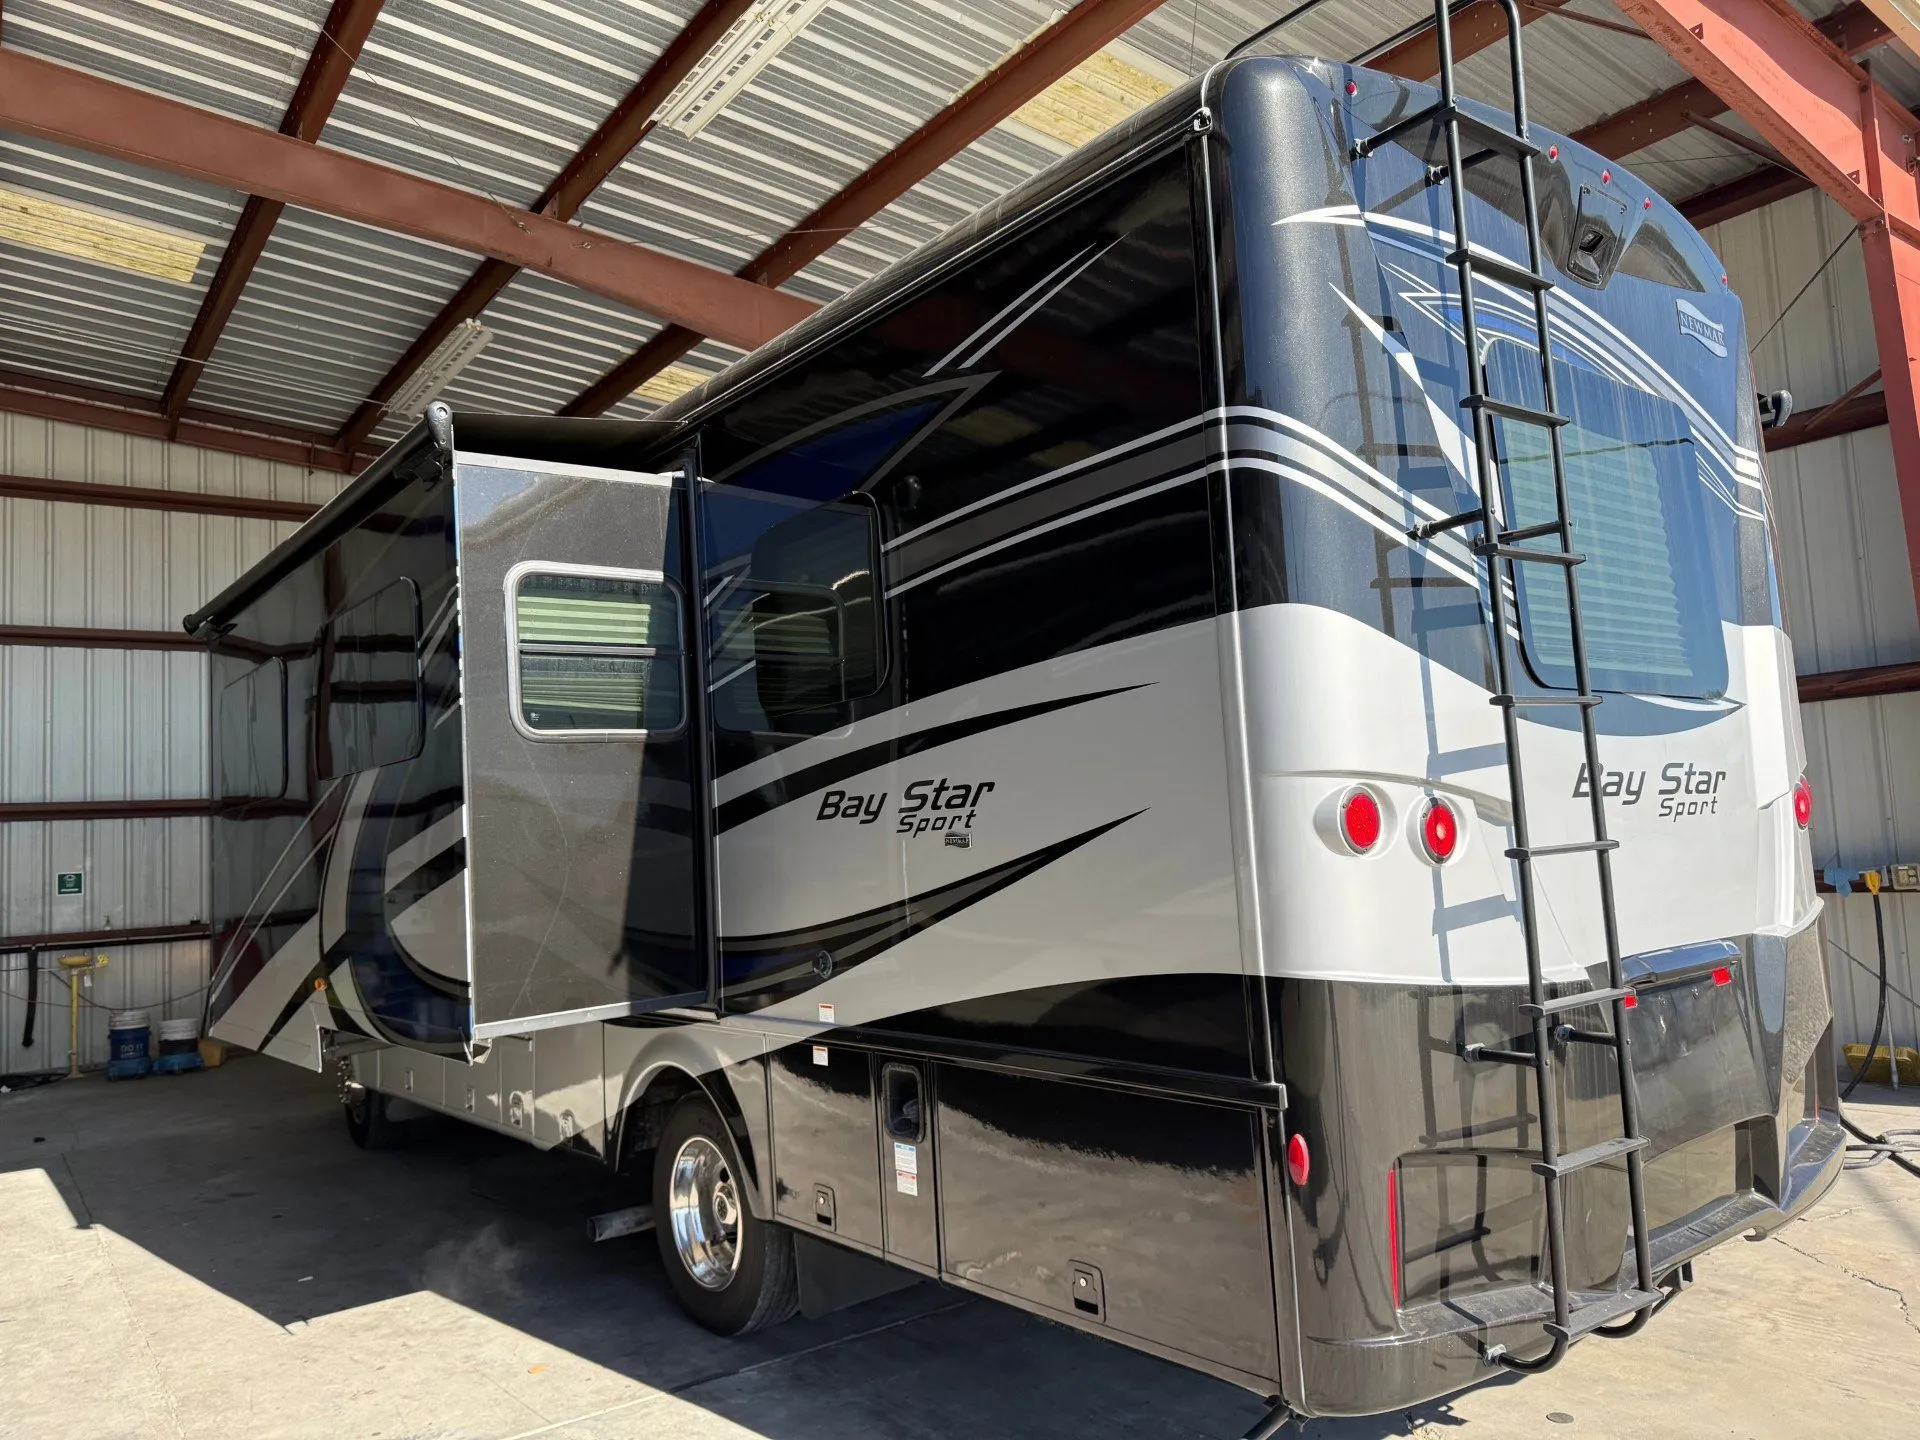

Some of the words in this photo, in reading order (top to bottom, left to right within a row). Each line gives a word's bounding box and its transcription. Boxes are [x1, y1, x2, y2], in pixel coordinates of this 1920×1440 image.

[1680, 313, 1725, 346] NEWMAR
[1658, 763, 1726, 795] Star
[816, 790, 887, 824] Bay
[898, 778, 995, 814] Star
[1658, 796, 1718, 822] Sport
[896, 810, 976, 838] Sport
